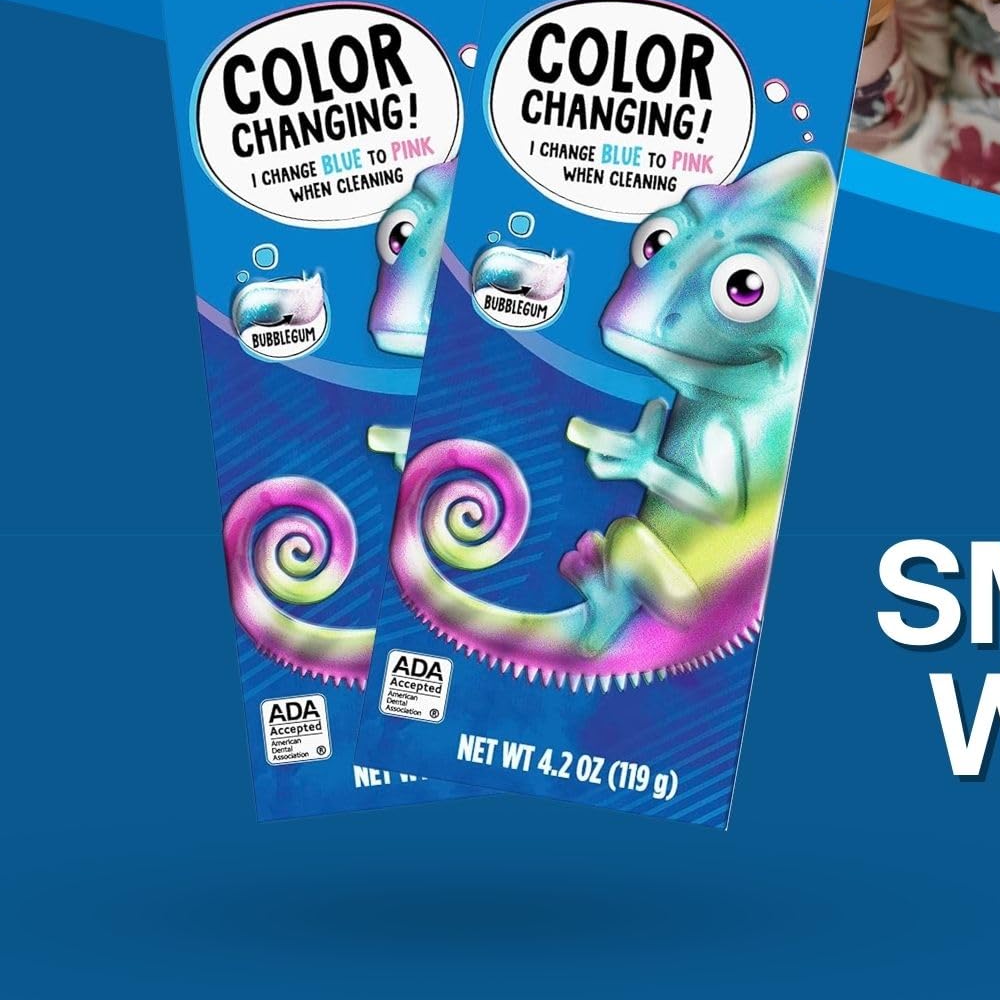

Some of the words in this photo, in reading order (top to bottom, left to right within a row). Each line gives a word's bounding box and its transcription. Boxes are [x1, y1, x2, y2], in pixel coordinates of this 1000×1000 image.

[222, 23, 412, 115] COLOR
[528, 22, 715, 100] COLOR
[231, 92, 418, 158] CHANGING!
[522, 89, 712, 144] CHANGING!
[251, 172, 257, 188] I
[262, 161, 317, 186] CHANGE
[321, 149, 362, 175] BLUE
[367, 149, 387, 166] TO
[391, 137, 435, 162] PINK
[530, 141, 534, 155] I
[540, 142, 596, 162] CHANGE
[601, 144, 642, 167] BLUE
[648, 152, 666, 169] TO
[672, 151, 714, 174] PINK
[290, 181, 332, 202] WHEN
[337, 168, 403, 195] CLEANING
[563, 167, 606, 185] WHEN
[610, 171, 677, 192] CLEANING
[484, 295, 548, 319] BUBBLEGUM
[251, 328, 316, 348] BUBBLEGUM
[392, 656, 443, 681] ADA
[387, 691, 418, 701] American
[390, 678, 442, 694] Accepted
[269, 700, 320, 723] ADA
[385, 705, 421, 716] Association
[387, 698, 408, 707] Dental
[270, 721, 322, 736] Accepted
[272, 738, 301, 747] American
[273, 751, 309, 761] Association
[457, 734, 499, 765] NET
[502, 741, 535, 771] WT
[537, 748, 573, 778] 4.2
[576, 755, 604, 784] OZ
[608, 760, 650, 792] (119
[653, 770, 678, 800] g)
